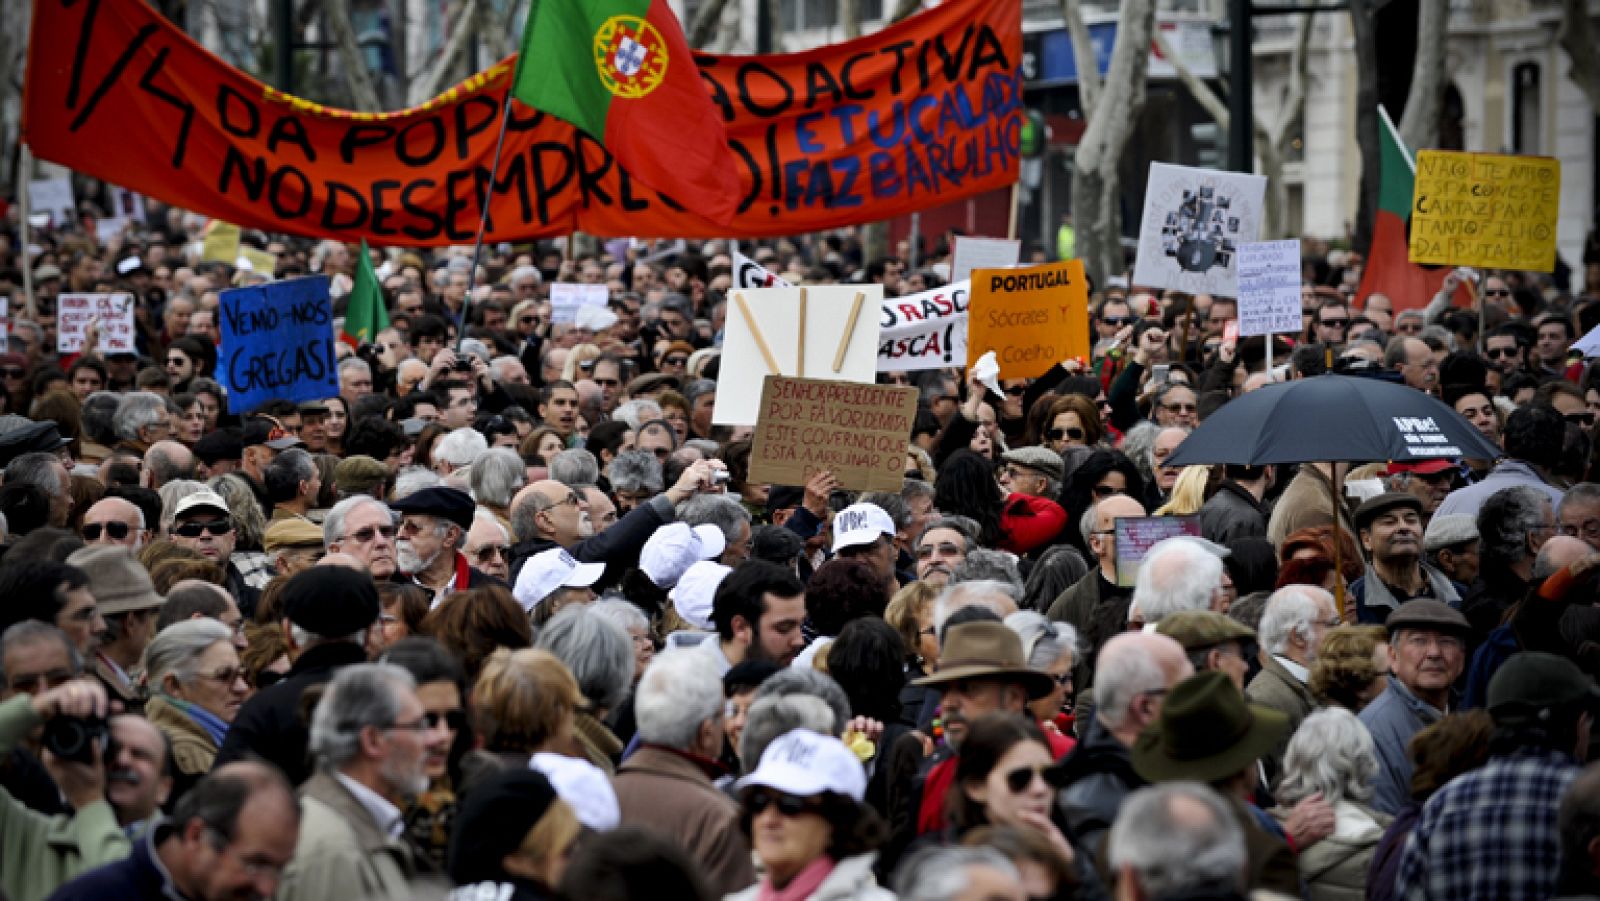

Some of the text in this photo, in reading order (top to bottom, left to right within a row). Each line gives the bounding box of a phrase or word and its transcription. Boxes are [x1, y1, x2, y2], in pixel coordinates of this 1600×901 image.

[216, 84, 317, 163] DA
[804, 23, 1009, 108] ACTIVA
[784, 114, 1020, 211] FAZ BARULHO
[219, 144, 314, 220] NO
[1416, 195, 1546, 220] CARTAZ PARA
[1414, 237, 1441, 258] DA
[990, 269, 1071, 293] PORTUGAL
[898, 290, 969, 323] RASC
[987, 307, 1049, 328] Sócrates
[229, 338, 337, 393] GREGAS!
[1001, 343, 1055, 364] Coelho
[771, 378, 826, 403] SENHOR
[768, 402, 803, 420] POR
[766, 423, 798, 442] ESTE
[877, 436, 906, 453] QUE
[887, 456, 901, 472] O
